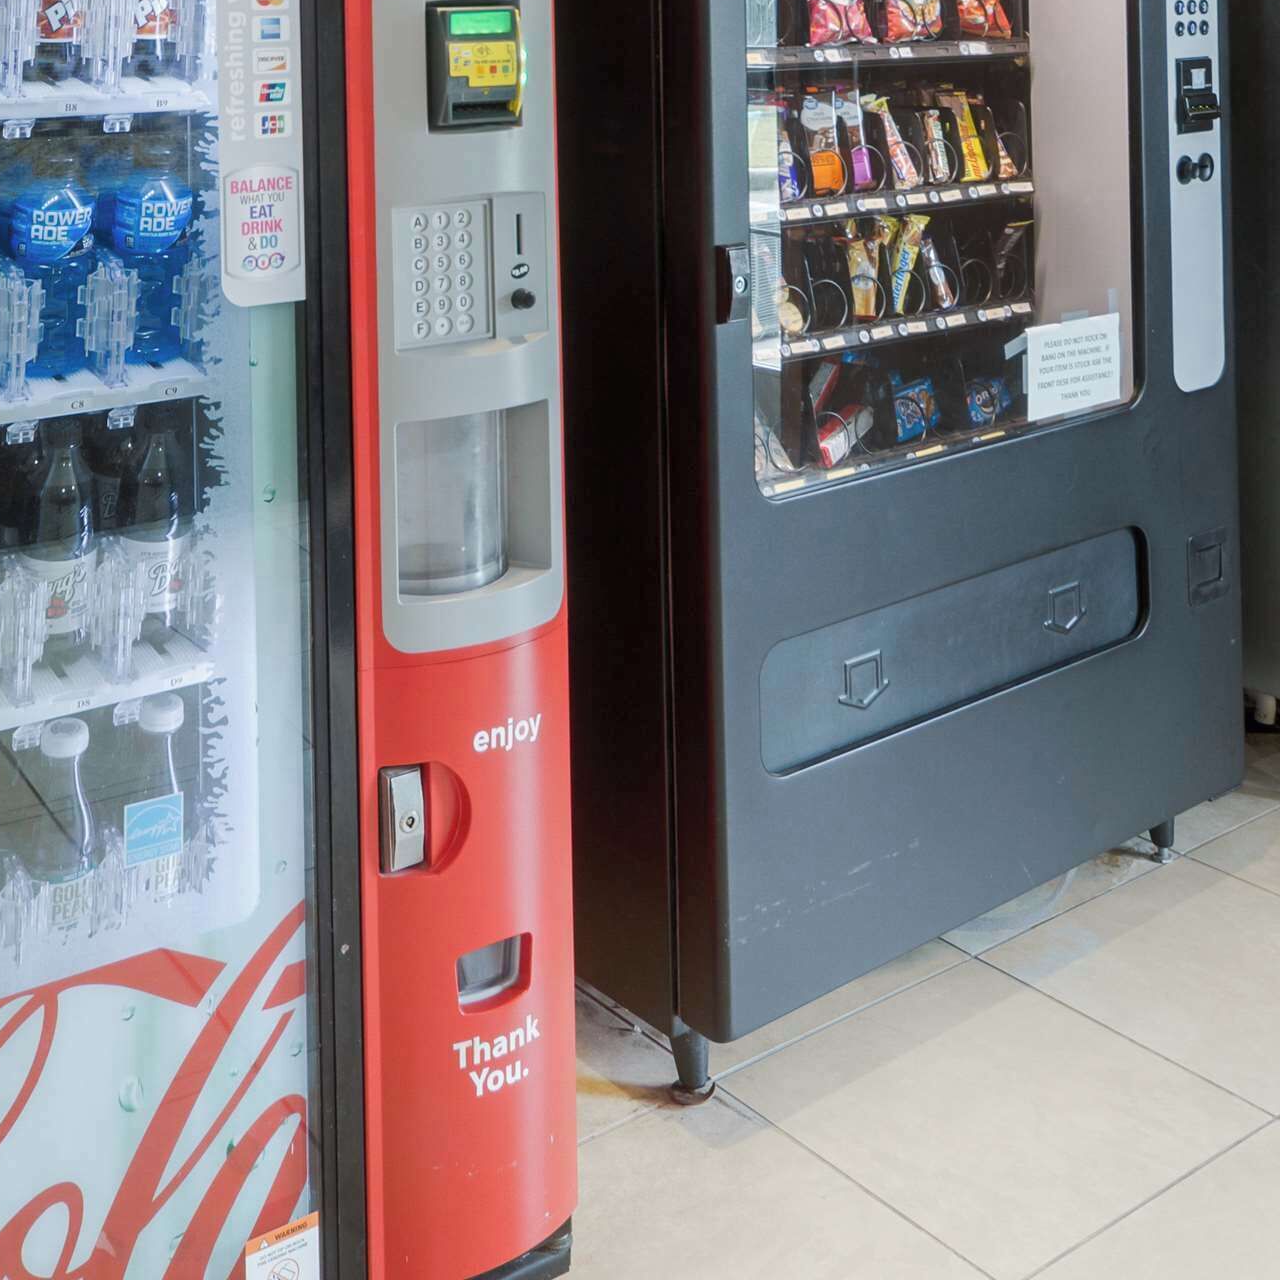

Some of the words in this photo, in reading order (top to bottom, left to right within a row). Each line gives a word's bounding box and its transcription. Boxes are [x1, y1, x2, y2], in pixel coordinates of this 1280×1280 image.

[65, 103, 77, 112] B8
[156, 99, 168, 107] B9
[230, 176, 293, 194] BALANCE
[240, 193, 266, 205] WHAT
[268, 191, 286, 202] YOU
[32, 206, 93, 225] POWER
[250, 204, 274, 219] EAT
[139, 217, 175, 232] ADE
[241, 218, 283, 236] DRINK
[414, 217, 421, 228] A
[438, 215, 442, 225] 1
[458, 213, 465, 224] 2
[31, 224, 69, 241] ADE
[248, 236, 257, 251] &
[260, 234, 278, 249] DO
[415, 238, 422, 249] B
[437, 236, 444, 247] 3
[458, 233, 465, 243] 4
[415, 259, 423, 271] C
[438, 257, 444, 268] 5
[459, 254, 466, 265] 6
[415, 280, 423, 292] D
[438, 278, 445, 289] 7
[459, 275, 466, 286] 8
[416, 302, 424, 313] E
[438, 299, 446, 310] 9
[460, 297, 467, 307] 0
[417, 323, 424, 335] F
[165, 387, 178, 396] C9
[71, 400, 84, 410] C8
[170, 676, 183, 686] D9
[77, 698, 90, 709] D8
[472, 711, 541, 752] enjoy
[452, 1014, 540, 1070] Thank
[468, 1066, 529, 1098] You.
[275, 1221, 309, 1241] WARNING
